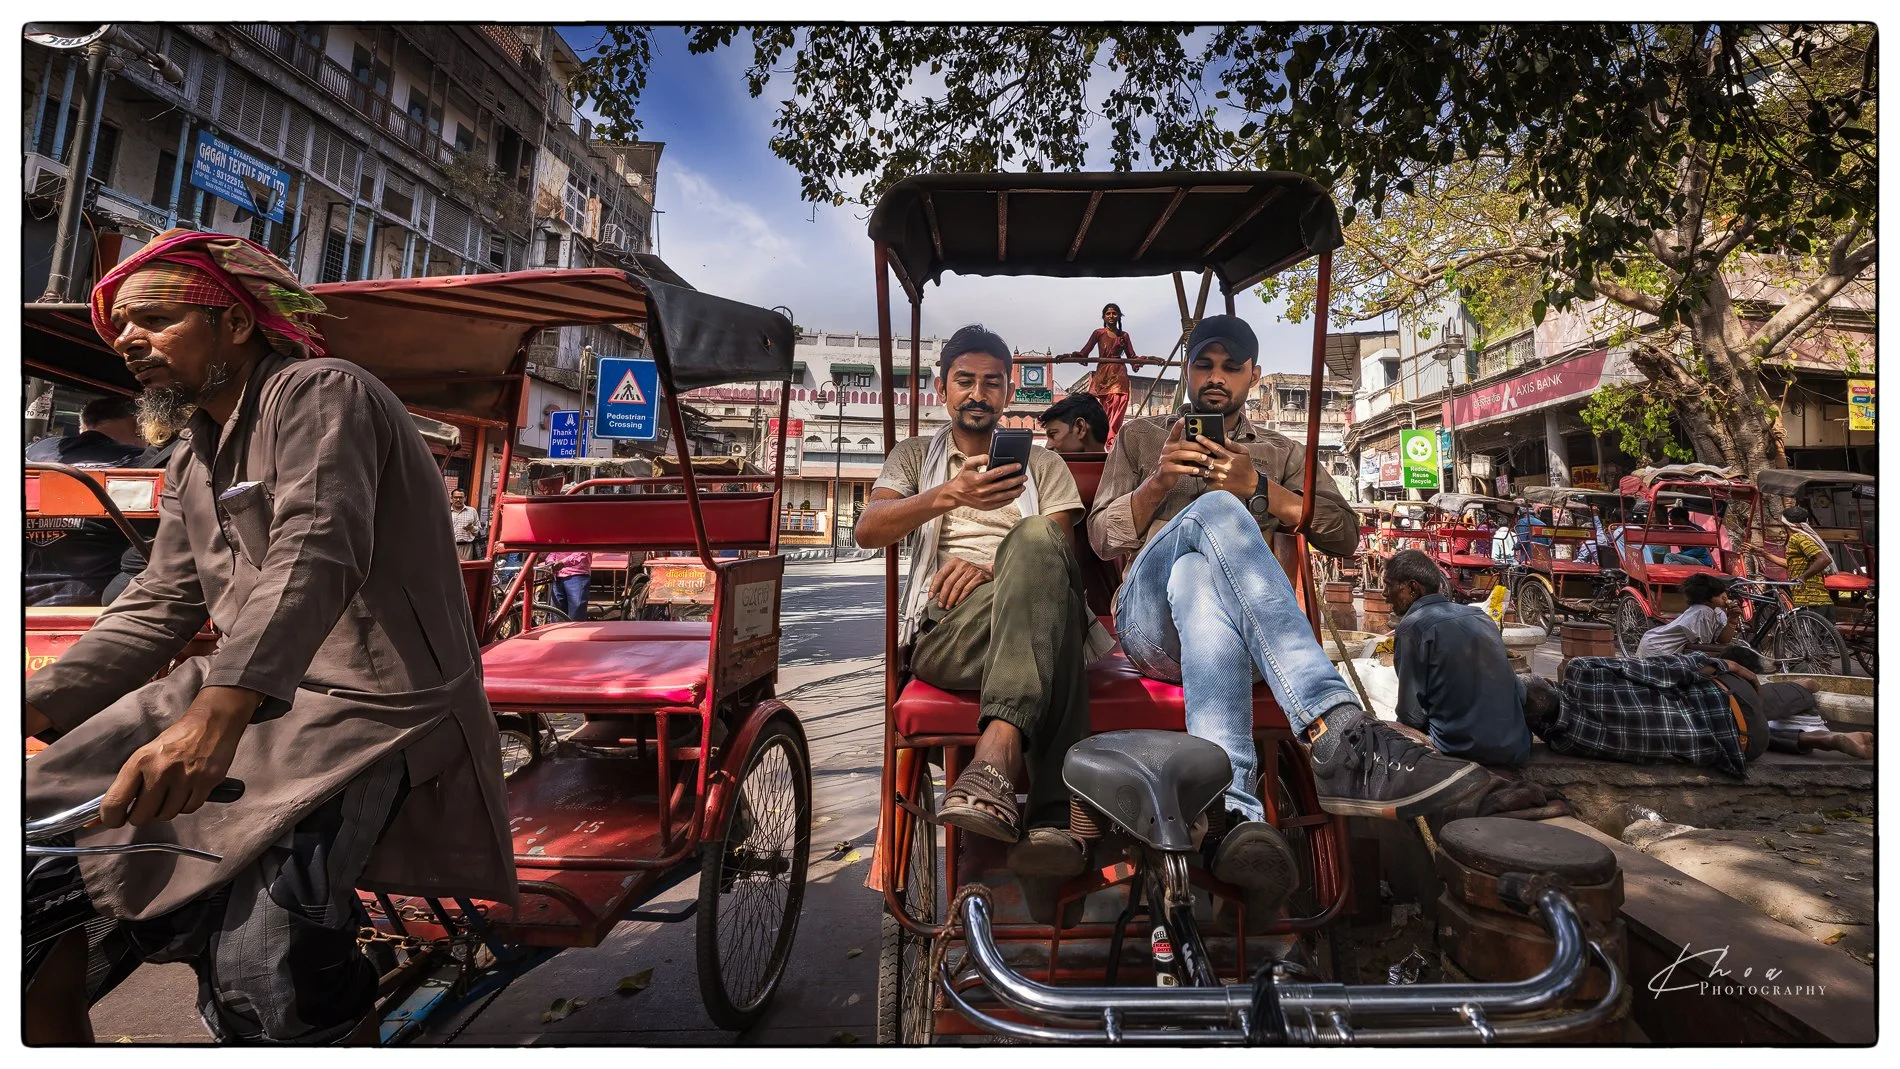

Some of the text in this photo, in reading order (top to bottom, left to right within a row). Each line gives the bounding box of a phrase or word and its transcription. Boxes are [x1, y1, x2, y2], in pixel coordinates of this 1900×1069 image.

[199, 142, 227, 169] GAGAN
[196, 159, 212, 174] Mob.
[1515, 373, 1563, 397] AXIS BANK
[606, 412, 646, 420] Pedestrian
[608, 420, 643, 429] Crossing
[553, 428, 586, 436] Thank Yu
[552, 438, 586, 446] PWD Lit
